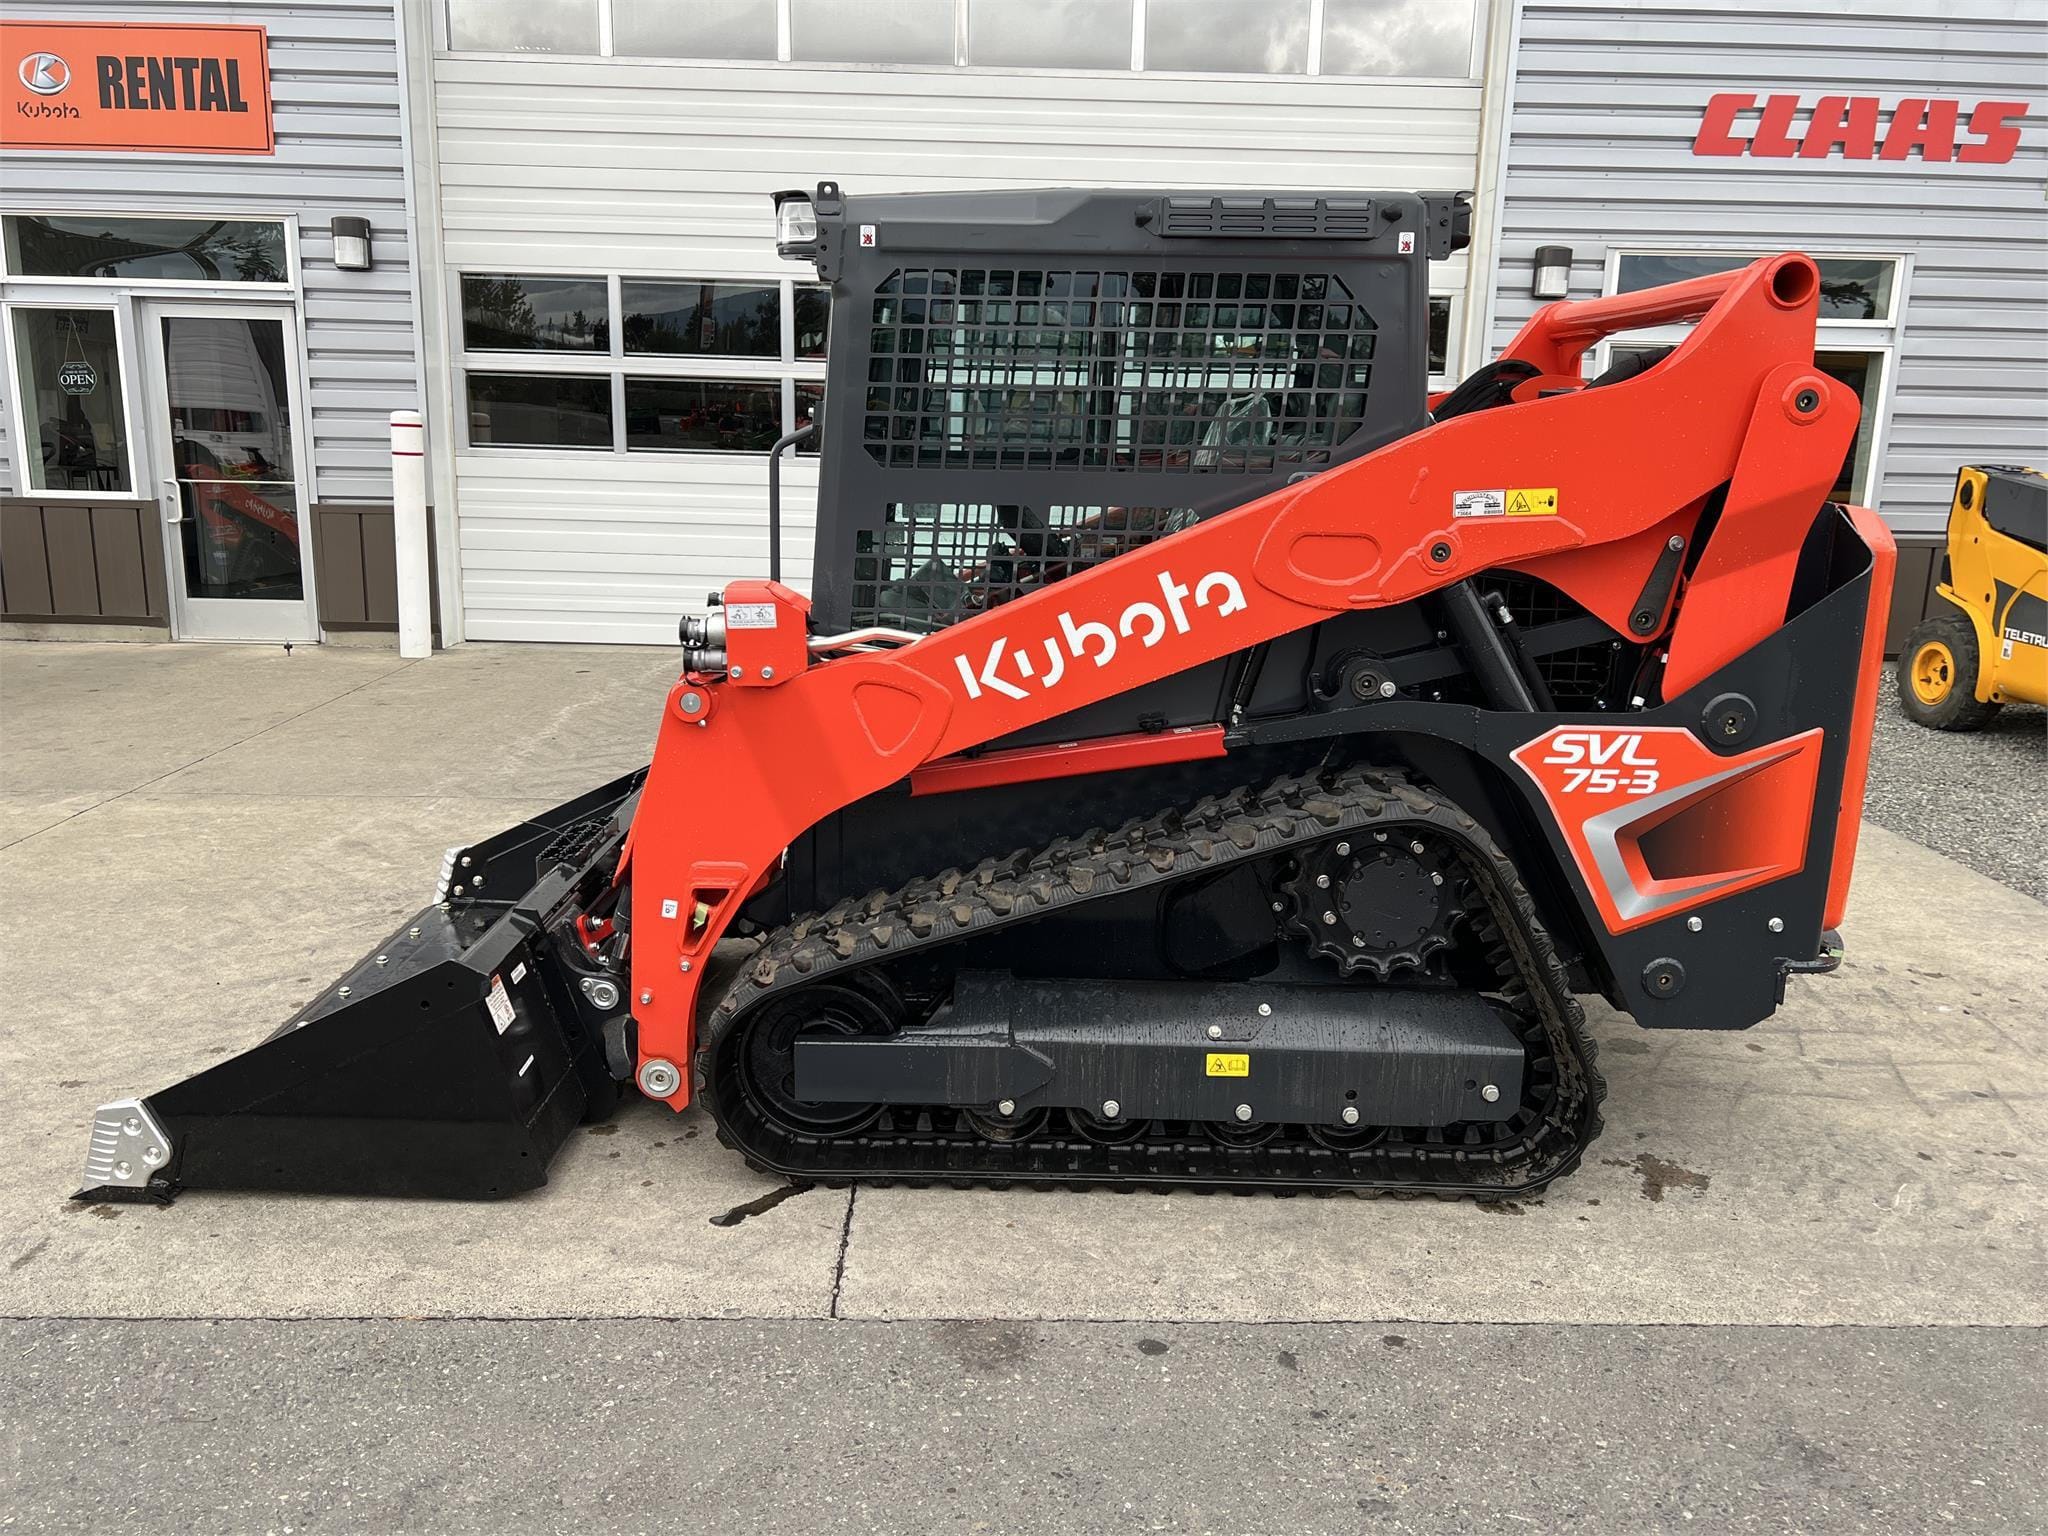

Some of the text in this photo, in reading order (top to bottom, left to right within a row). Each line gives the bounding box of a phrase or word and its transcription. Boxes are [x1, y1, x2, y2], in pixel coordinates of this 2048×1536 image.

[96, 55, 248, 112] RENTAL
[17, 101, 81, 119] Kubota
[1692, 93, 2030, 164] CLAAS
[60, 374, 95, 385] OPEN
[954, 571, 1248, 700] Kubota
[1542, 733, 1658, 766] SVL
[1560, 768, 1660, 794] 75-3
